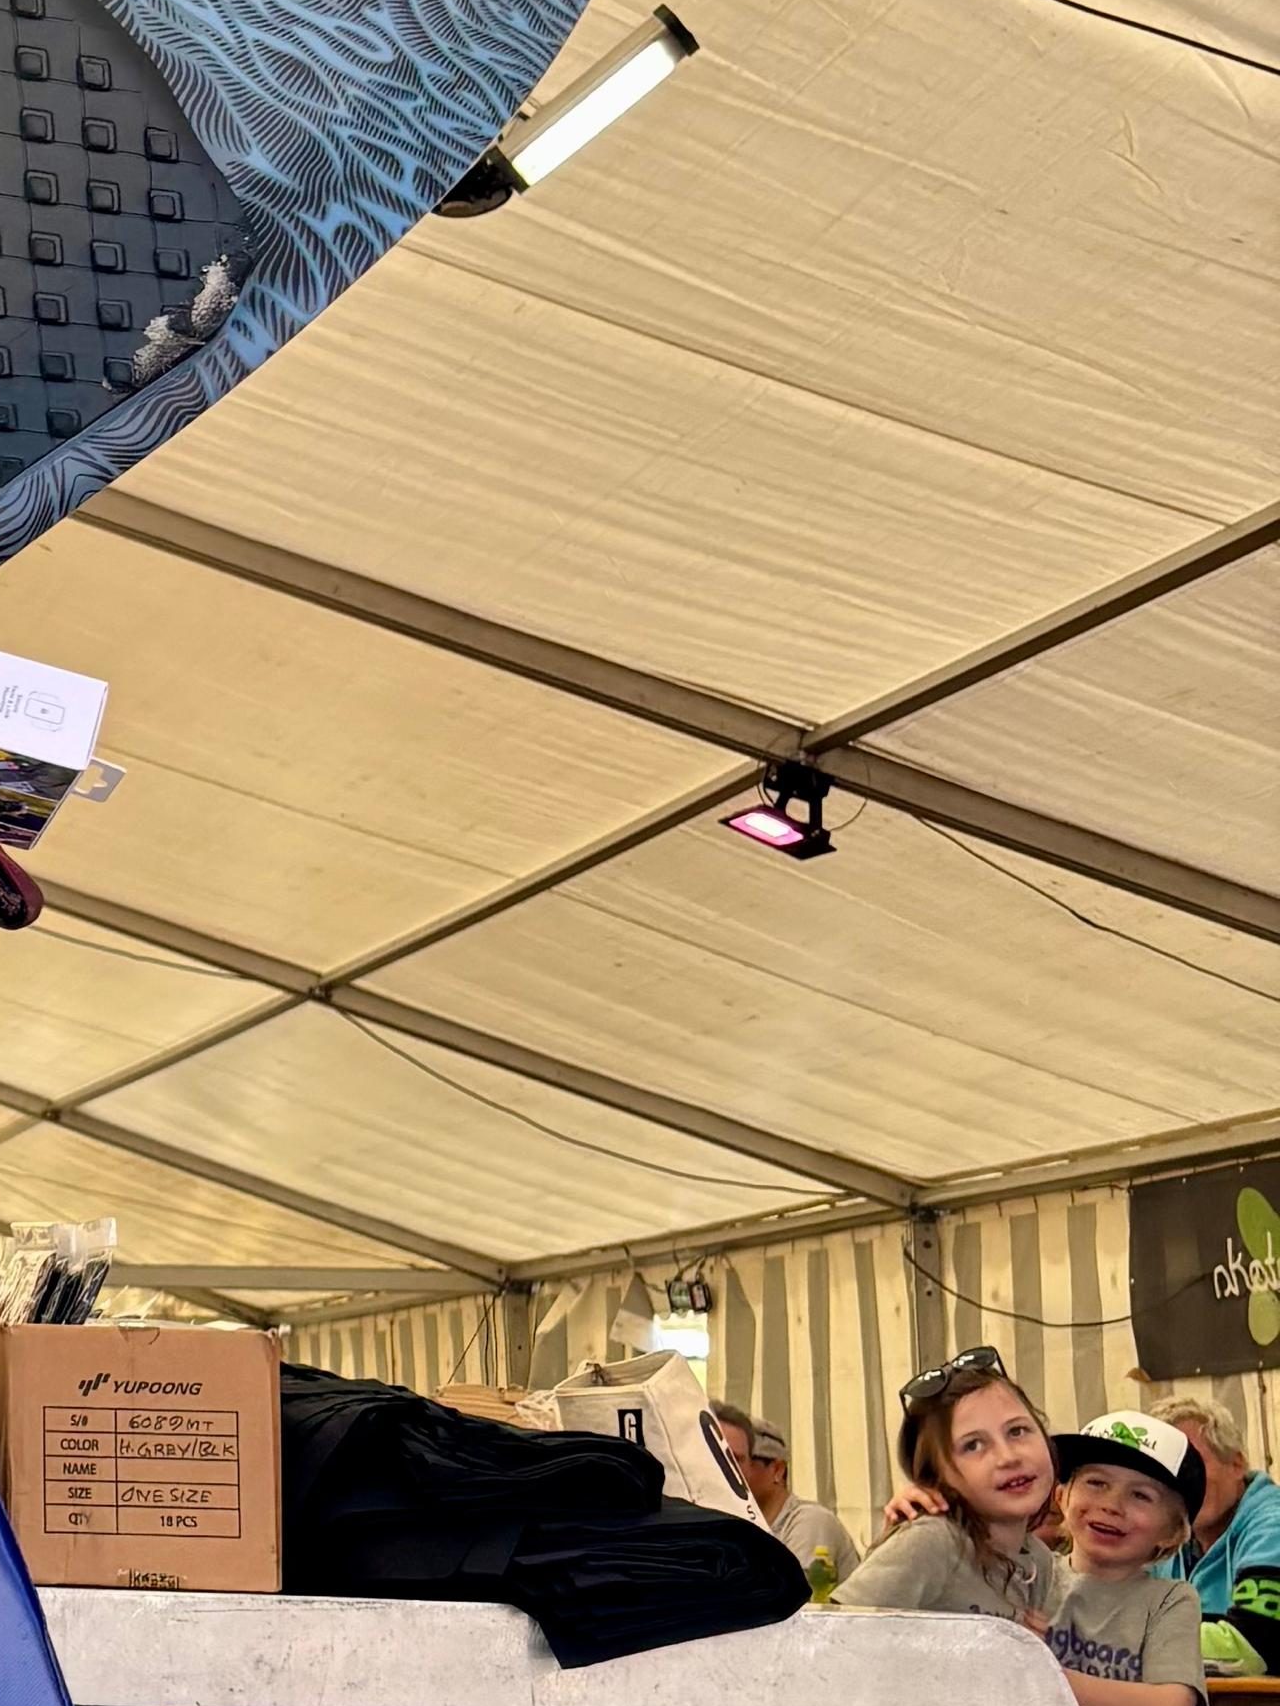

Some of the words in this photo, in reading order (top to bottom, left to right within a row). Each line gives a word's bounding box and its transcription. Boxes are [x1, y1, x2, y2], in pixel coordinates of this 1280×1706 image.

[112, 1380, 203, 1395] YUPOONG
[60, 1438, 100, 1451] COLOR
[62, 1462, 97, 1475] NAME
[67, 1486, 92, 1499] SIZE
[120, 1486, 165, 1503] ONE
[170, 1488, 213, 1503] SIZE
[176, 1516, 198, 1528] PCS
